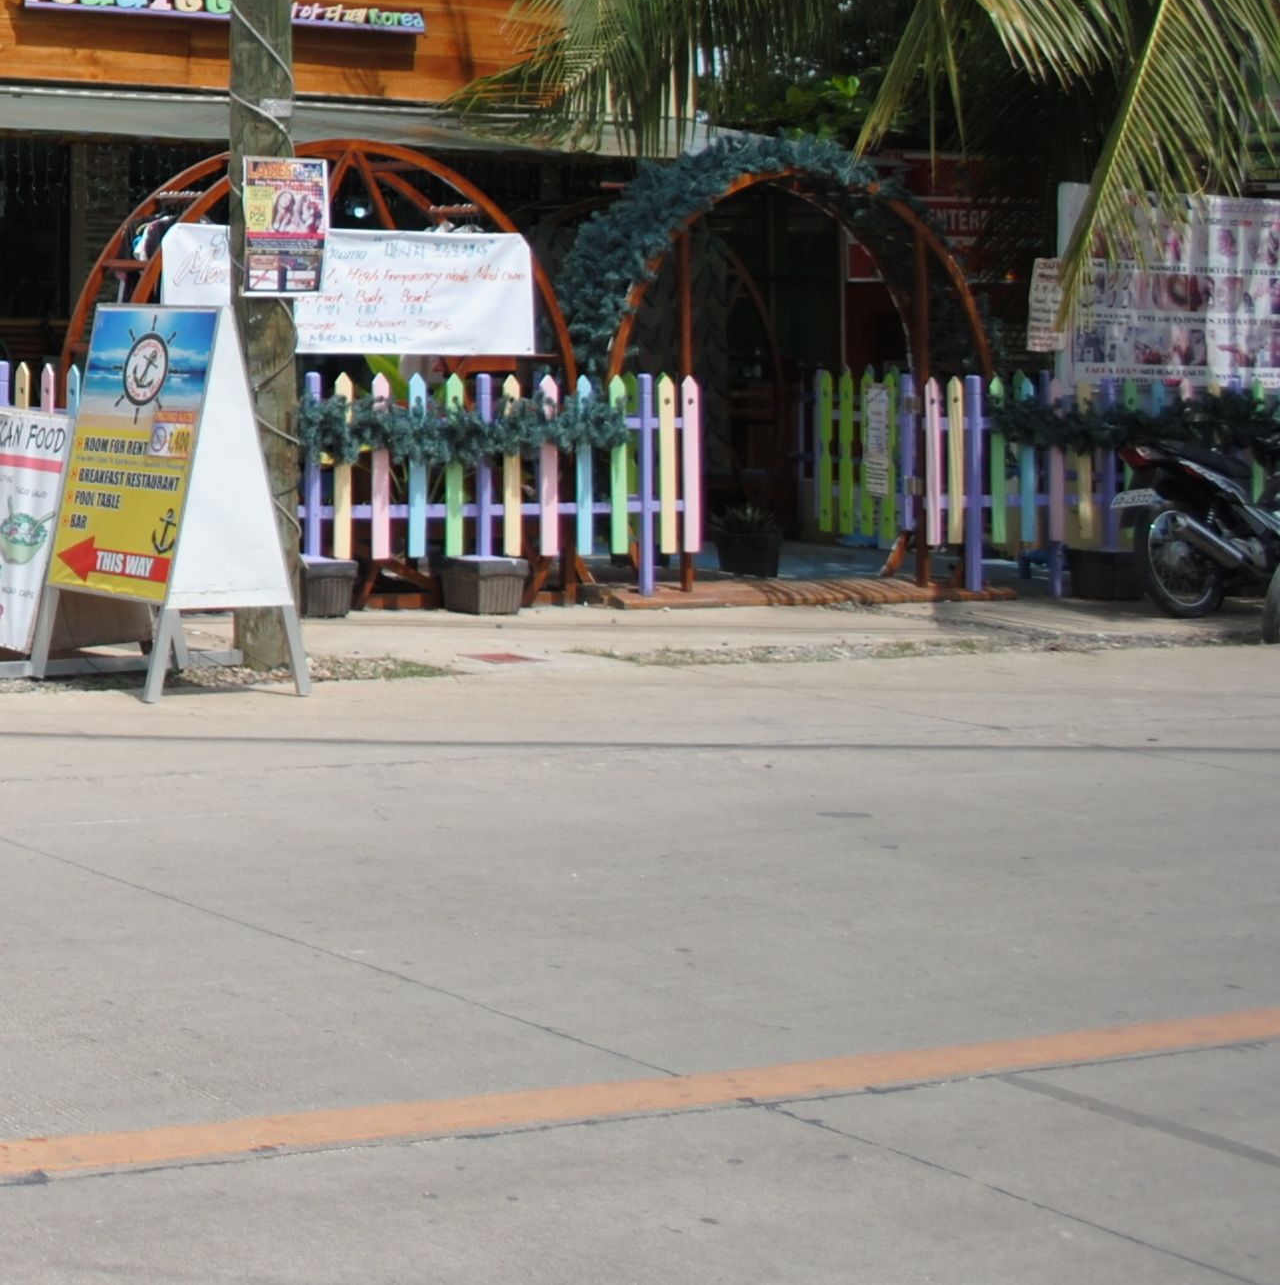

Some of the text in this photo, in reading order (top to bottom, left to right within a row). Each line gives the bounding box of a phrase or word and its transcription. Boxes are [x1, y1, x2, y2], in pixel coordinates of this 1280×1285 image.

[368, 7, 425, 28] Korea
[26, 424, 66, 453] FOOD
[84, 436, 149, 456] ROOM FOR RENT
[78, 468, 180, 492] BREAKFAST RESTAURANT
[74, 490, 121, 509] POOL TABLE
[70, 513, 88, 529] BAR
[96, 550, 154, 577] THIS WAY
